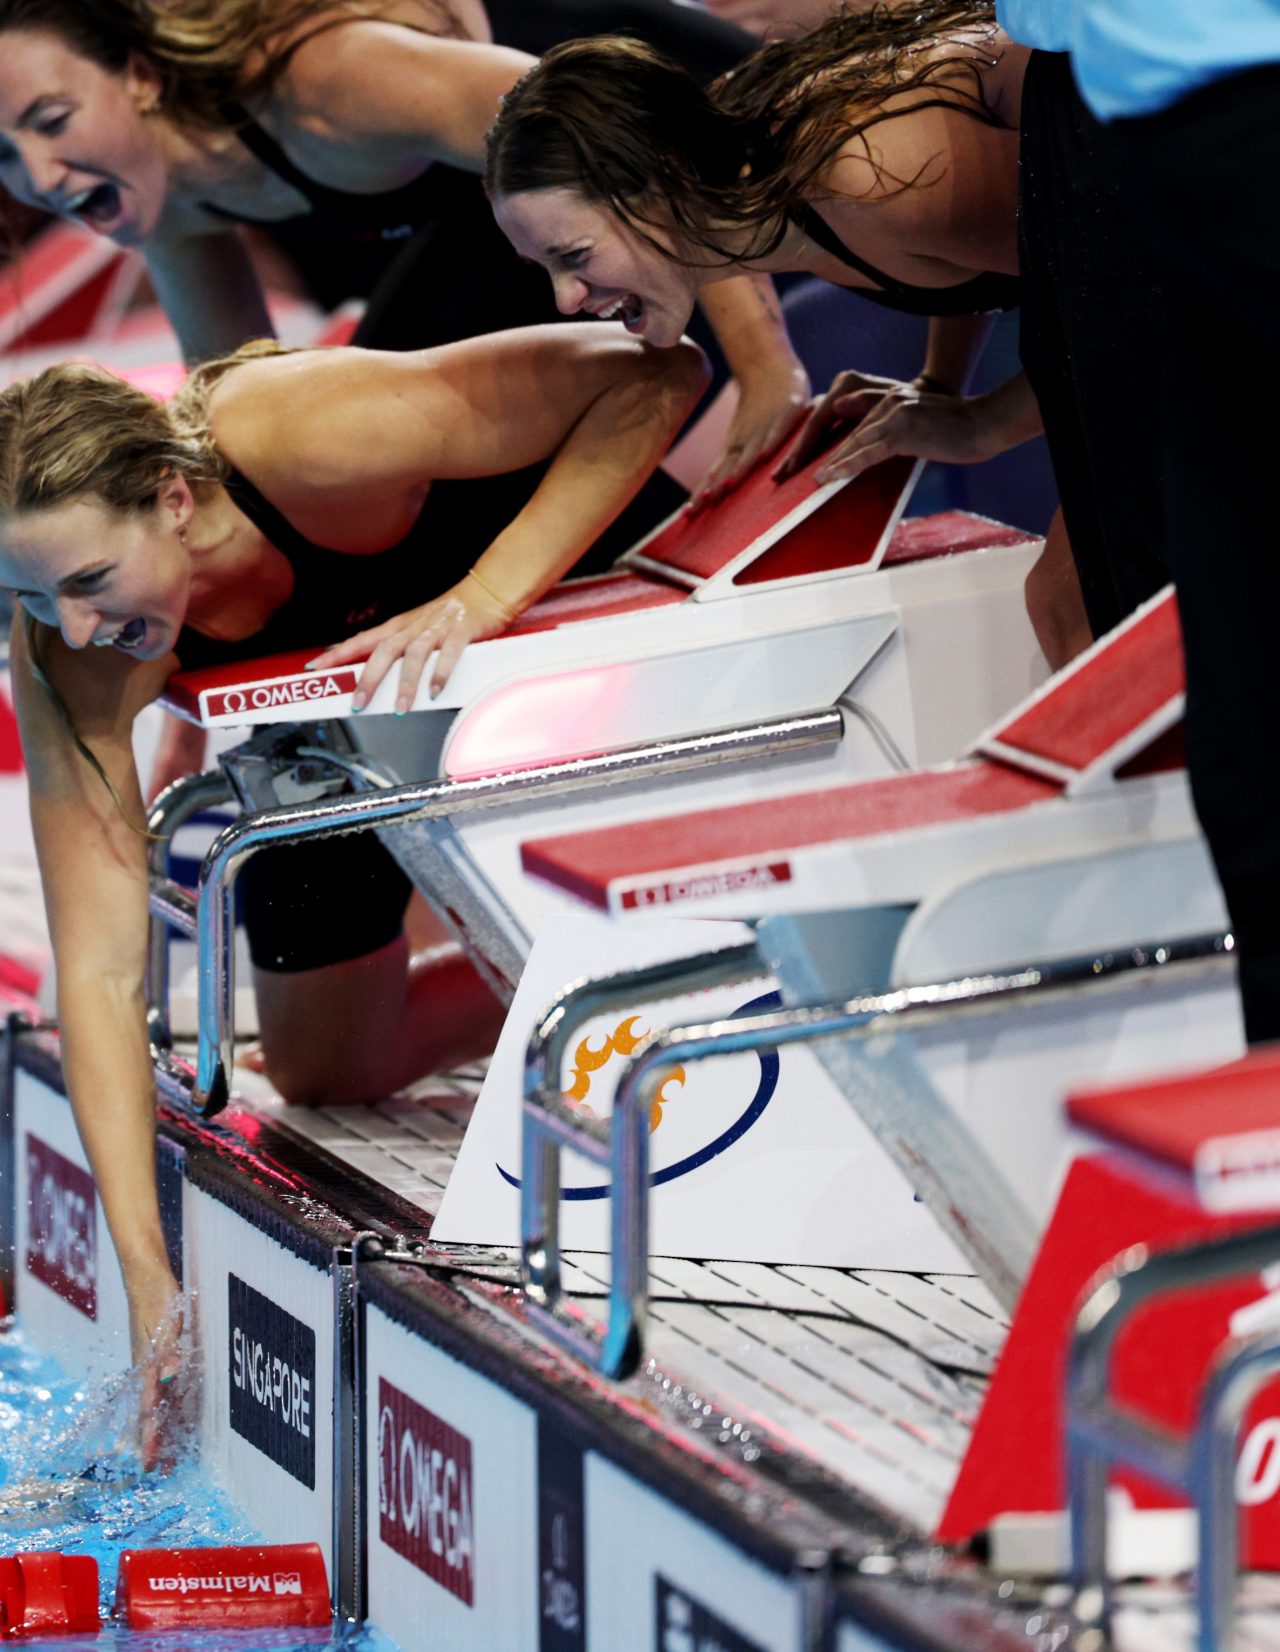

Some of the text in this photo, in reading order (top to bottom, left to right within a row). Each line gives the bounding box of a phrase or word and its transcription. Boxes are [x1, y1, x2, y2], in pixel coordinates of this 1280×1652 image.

[252, 677, 341, 708] OMEGA
[233, 1327, 310, 1438] SINGAPORE
[400, 1428, 473, 1570] OMEGA
[149, 1574, 271, 1594] Malmsten
